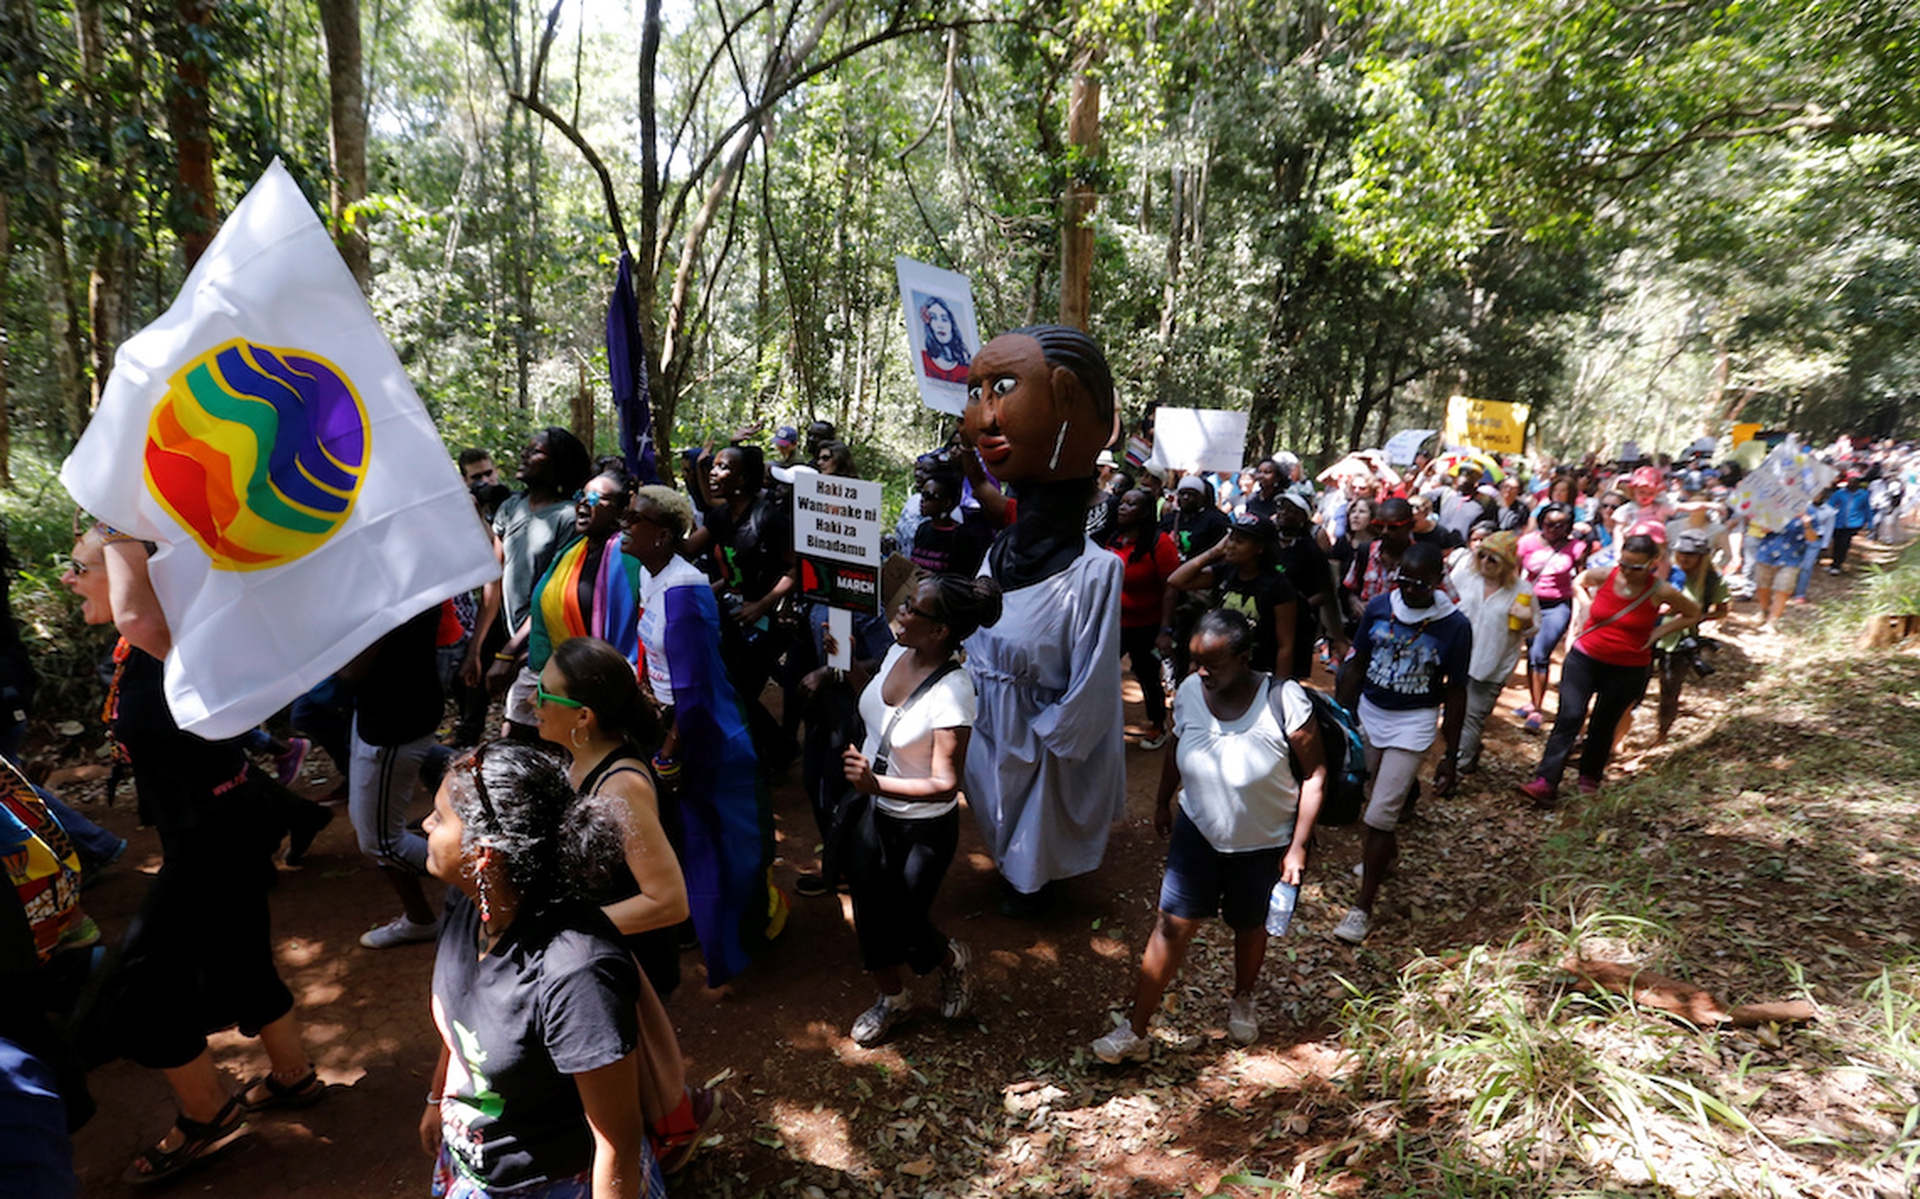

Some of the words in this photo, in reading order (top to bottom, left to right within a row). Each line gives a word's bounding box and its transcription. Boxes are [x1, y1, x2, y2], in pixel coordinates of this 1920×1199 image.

[816, 480, 842, 498] Haki
[844, 486, 858, 500] za
[798, 496, 862, 520] Wanawake
[864, 508, 877, 522] ni
[816, 518, 842, 535] Haki
[843, 524, 857, 537] za
[806, 534, 866, 557] Binadamu
[837, 576, 875, 595] MARCH
